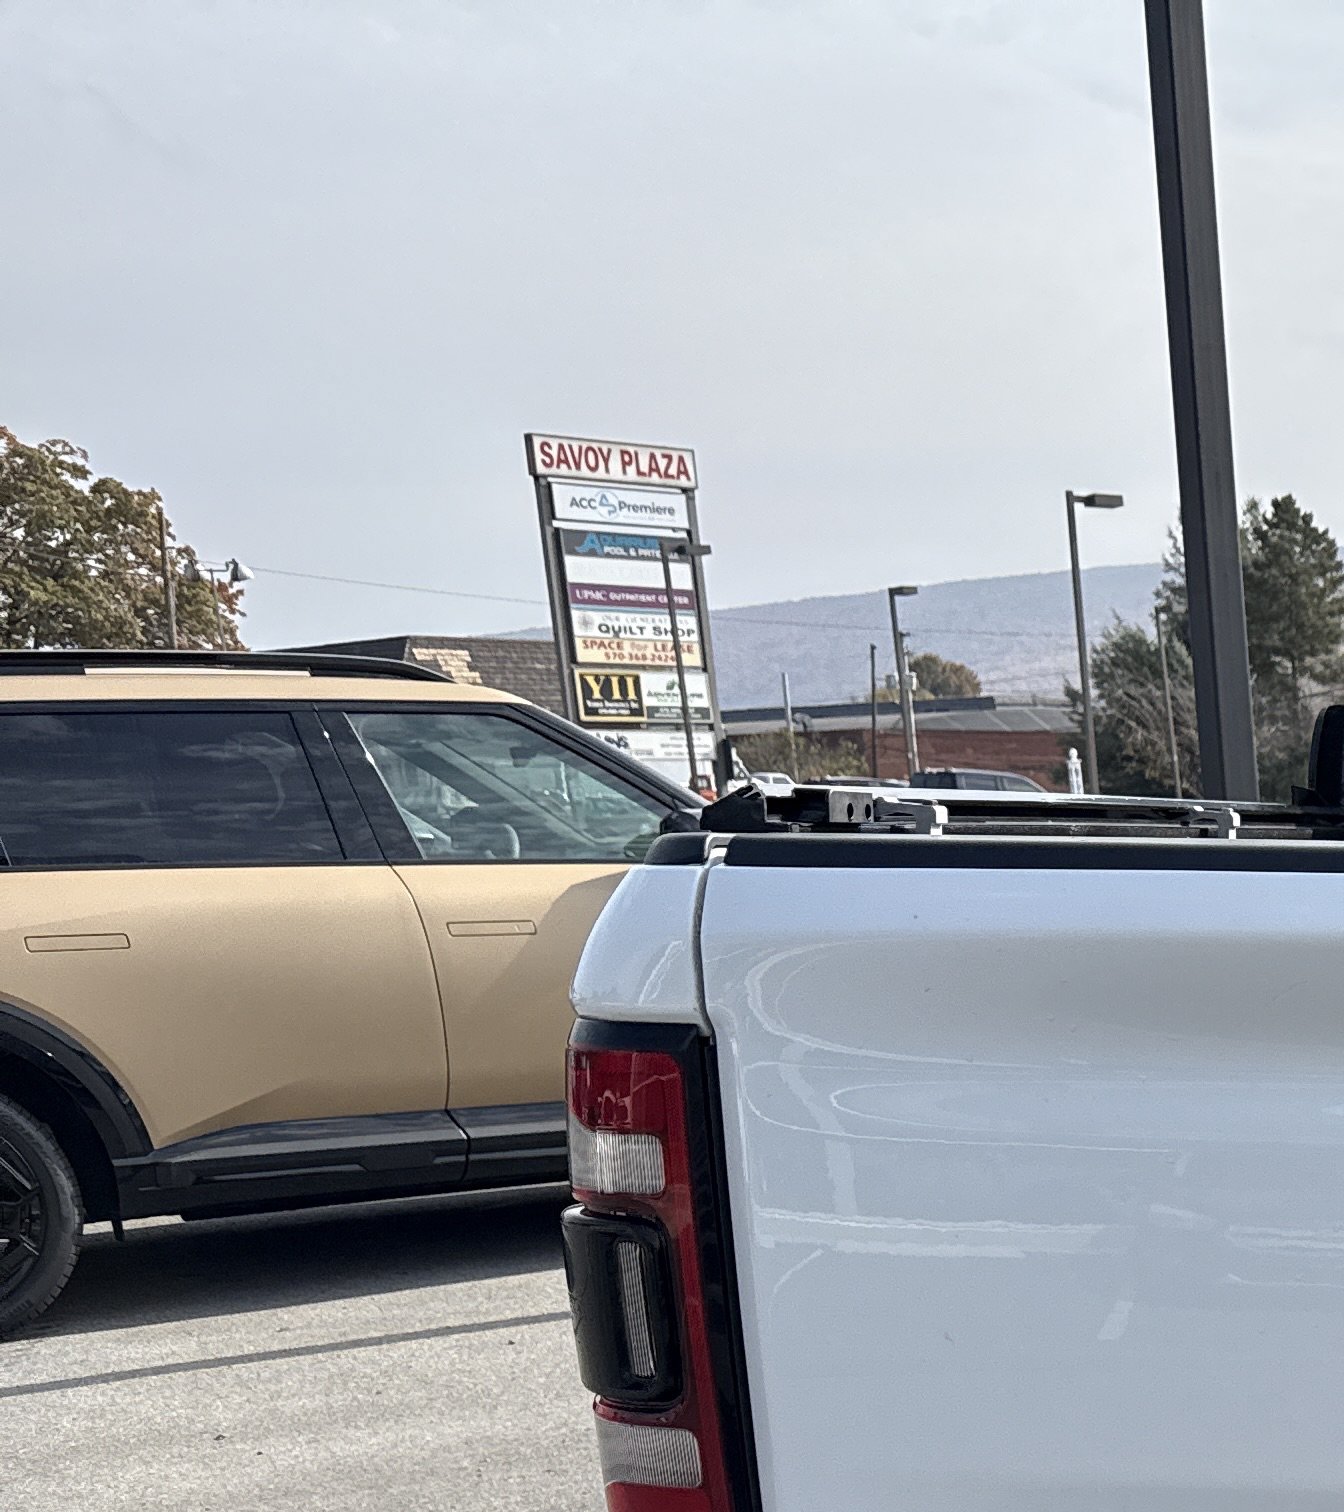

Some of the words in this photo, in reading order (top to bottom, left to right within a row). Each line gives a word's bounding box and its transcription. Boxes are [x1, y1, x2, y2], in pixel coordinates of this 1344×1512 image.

[540, 441, 612, 474] SAVOY
[619, 449, 691, 481] PLAZA
[569, 496, 597, 510] ACC
[618, 501, 676, 516] Premiere
[575, 589, 608, 601] UPMC
[598, 623, 646, 635] QUILT
[652, 626, 695, 638] SHOP
[582, 639, 624, 650] SPACE
[583, 675, 637, 700] YII
